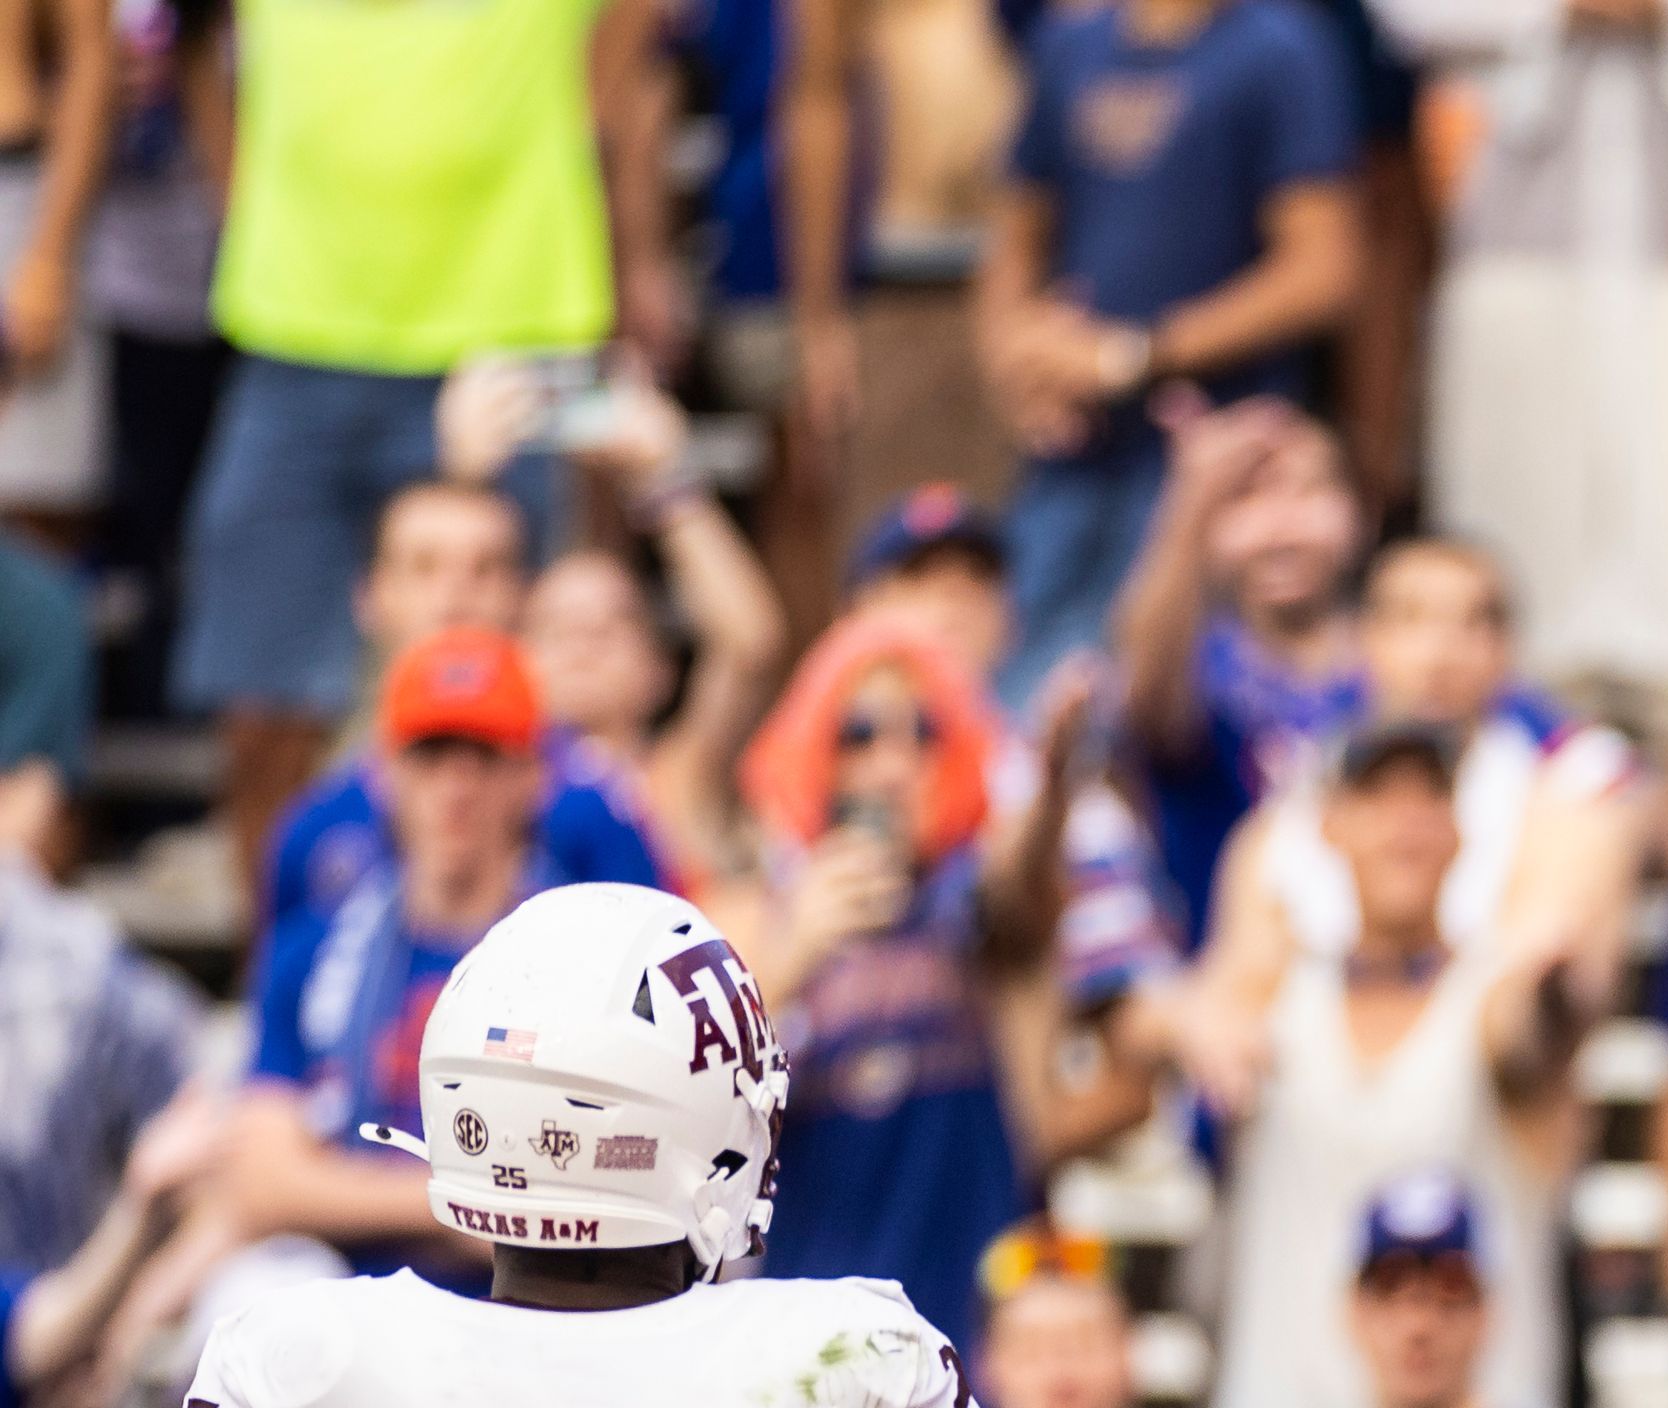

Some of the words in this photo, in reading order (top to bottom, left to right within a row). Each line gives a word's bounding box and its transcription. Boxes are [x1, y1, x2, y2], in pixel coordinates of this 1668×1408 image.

[457, 1113, 484, 1151] SEC
[491, 1164, 528, 1190] 25
[447, 1201, 529, 1239] TEXAS
